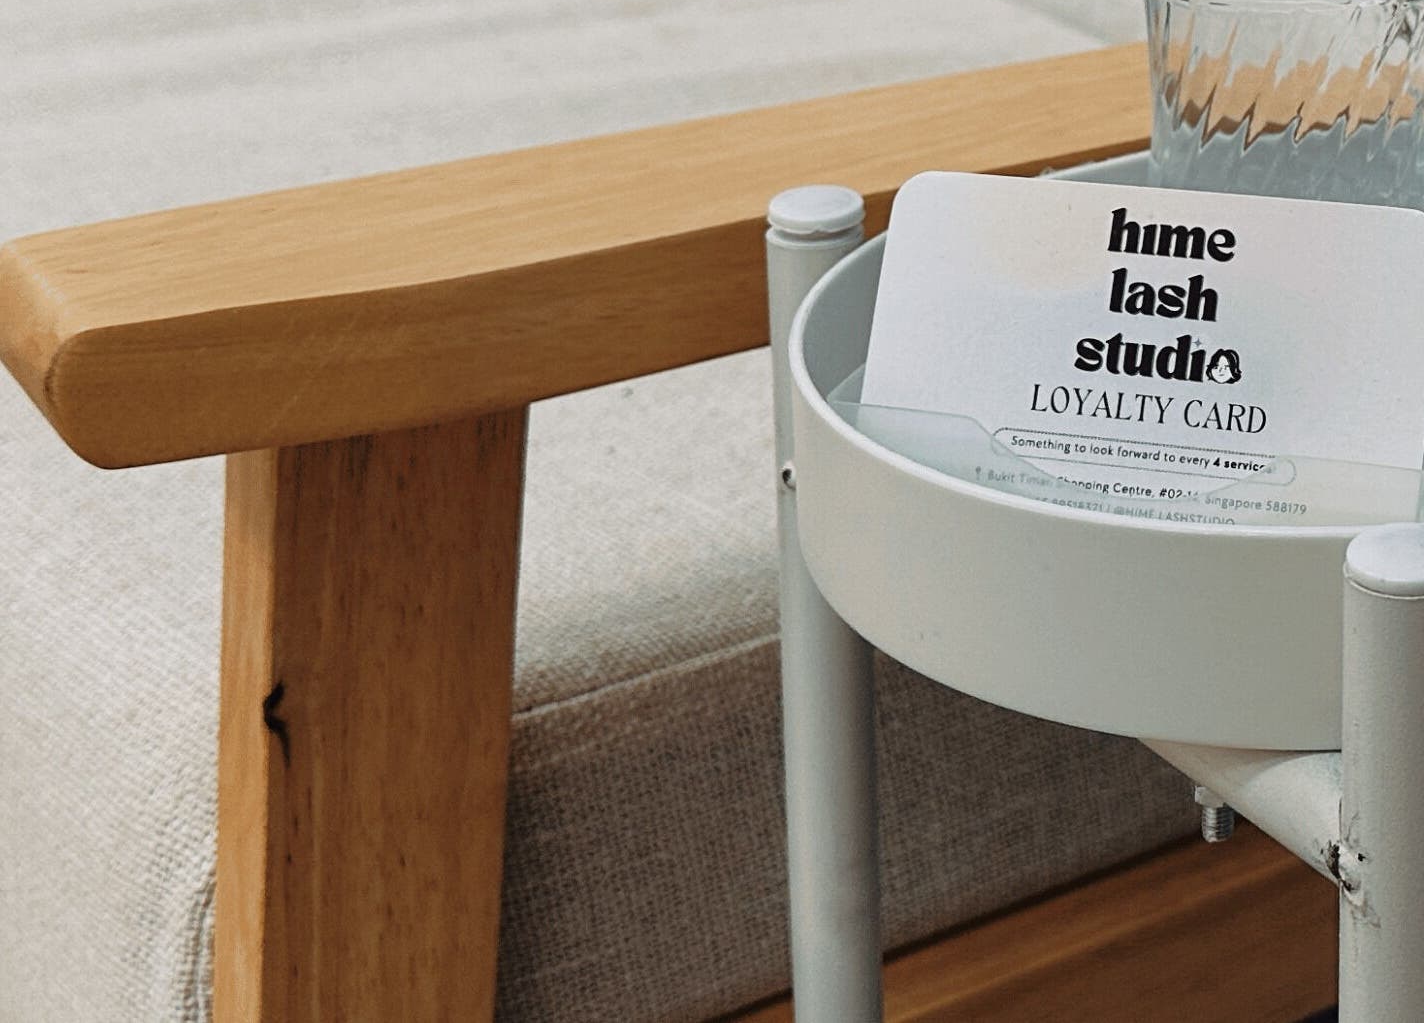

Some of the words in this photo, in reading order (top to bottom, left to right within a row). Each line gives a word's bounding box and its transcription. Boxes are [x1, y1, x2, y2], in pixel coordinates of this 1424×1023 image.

[1107, 207, 1236, 262] hime
[1109, 267, 1218, 322] lash
[1030, 384, 1174, 424] LOYALTY
[1184, 399, 1267, 434] CARD
[1011, 435, 1071, 454] Something
[1075, 443, 1086, 453] to
[1090, 444, 1113, 456] look
[1117, 447, 1160, 461] forward
[1164, 453, 1176, 462] to
[1179, 457, 1210, 469] every
[1213, 457, 1220, 467] 4
[1113, 482, 1155, 498] Centre,
[1266, 500, 1307, 515] 588179
